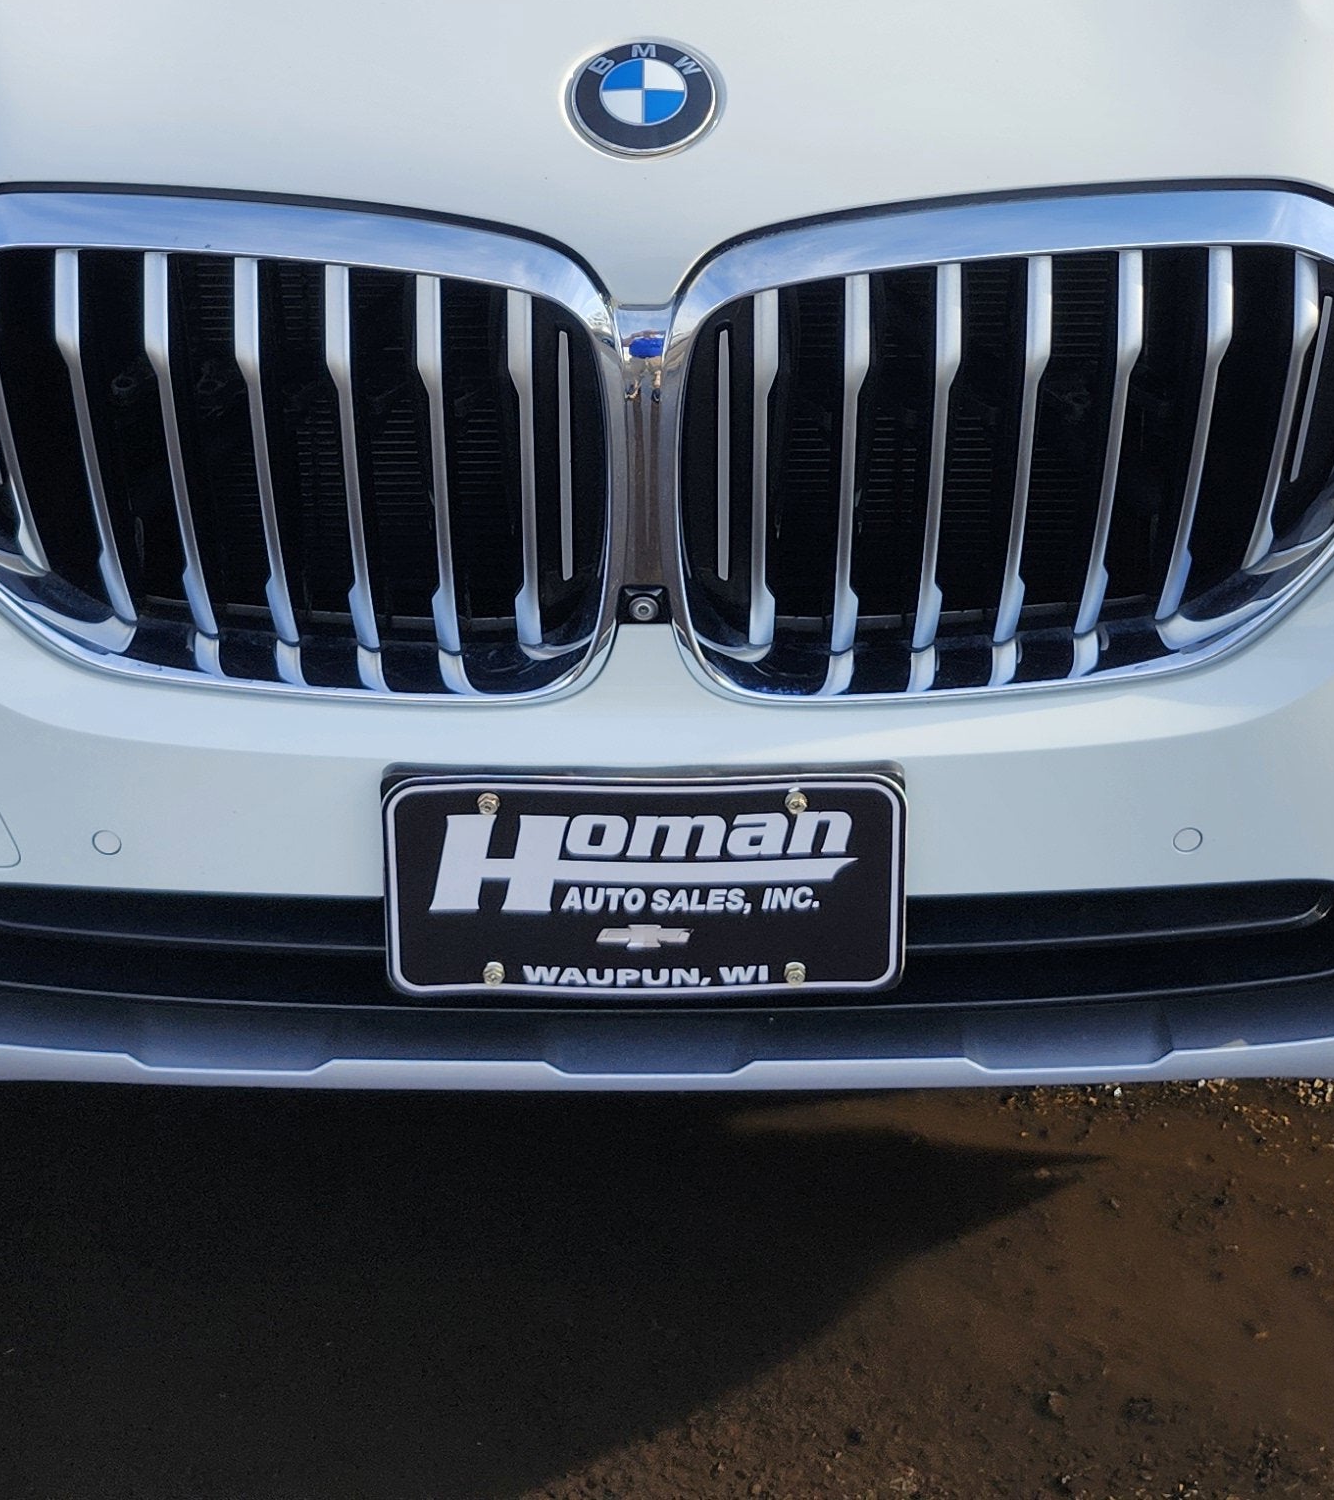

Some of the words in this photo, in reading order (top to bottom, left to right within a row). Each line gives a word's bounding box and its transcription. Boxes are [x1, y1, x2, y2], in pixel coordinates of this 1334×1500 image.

[586, 44, 702, 77] BMW
[429, 811, 854, 913] Homan
[560, 886, 646, 912] AUTO
[650, 887, 752, 915] SALES,
[761, 884, 820, 910] INC.
[522, 965, 712, 987] WAUPUN,
[718, 964, 769, 984] WI
